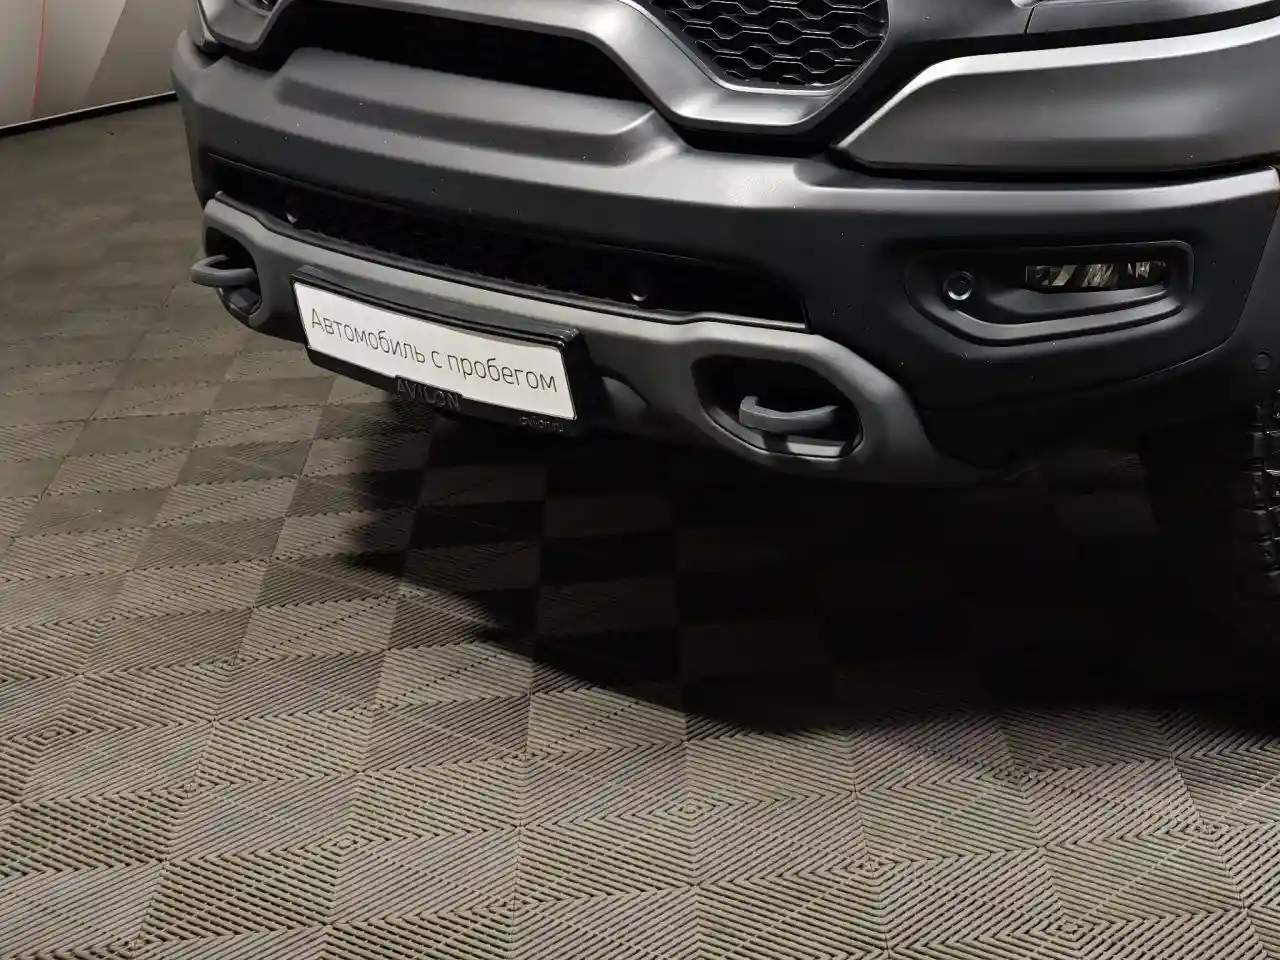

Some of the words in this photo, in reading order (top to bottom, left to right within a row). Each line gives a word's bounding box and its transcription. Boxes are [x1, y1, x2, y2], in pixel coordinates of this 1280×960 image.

[311, 307, 426, 365] Автомобиль
[431, 348, 443, 370] с
[448, 350, 558, 394] пробегом
[396, 378, 462, 413] AVILON
